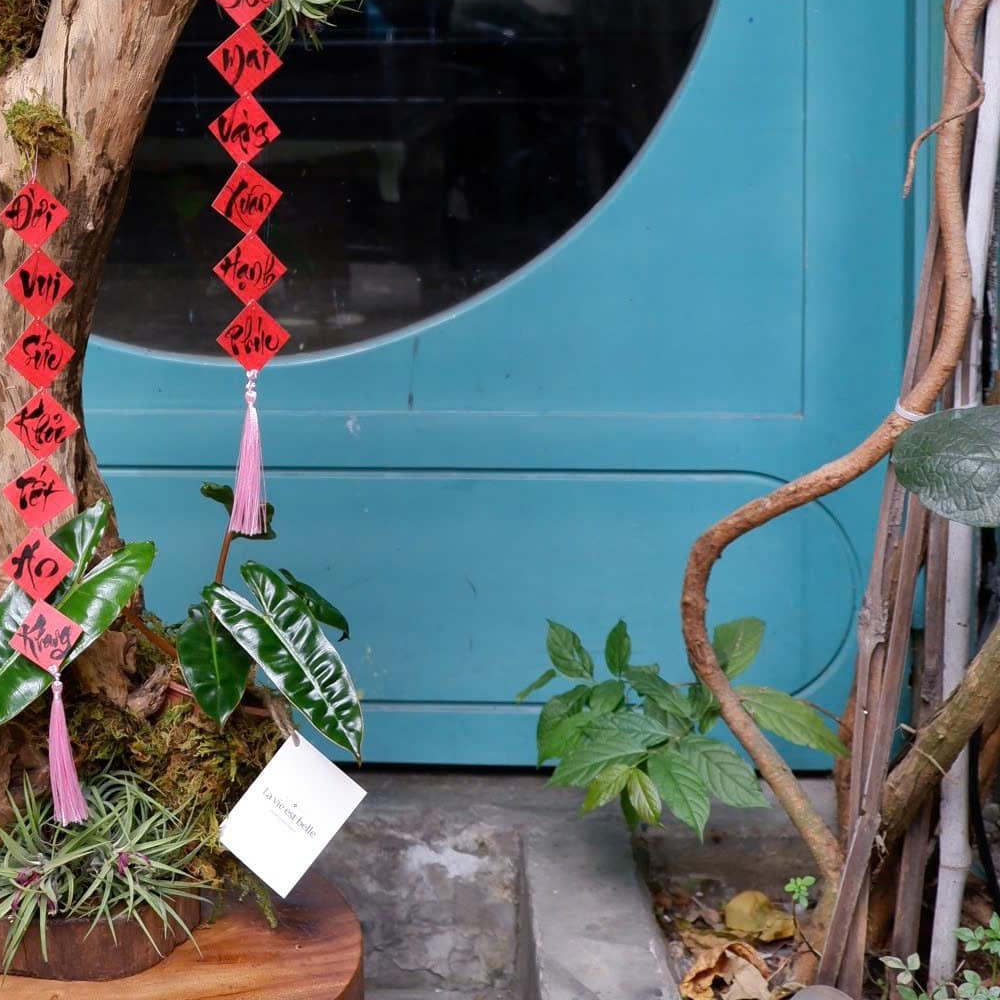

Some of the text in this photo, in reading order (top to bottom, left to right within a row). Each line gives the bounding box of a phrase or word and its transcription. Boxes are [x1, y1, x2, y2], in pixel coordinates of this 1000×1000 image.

[222, 44, 270, 85] Mai
[5, 188, 57, 231] Đời
[19, 261, 61, 305] Vui
[16, 465, 63, 512] Tết
[262, 786, 273, 800] La
[273, 796, 286, 810] vie
[283, 808, 297, 821] est
[296, 816, 317, 839] belle
